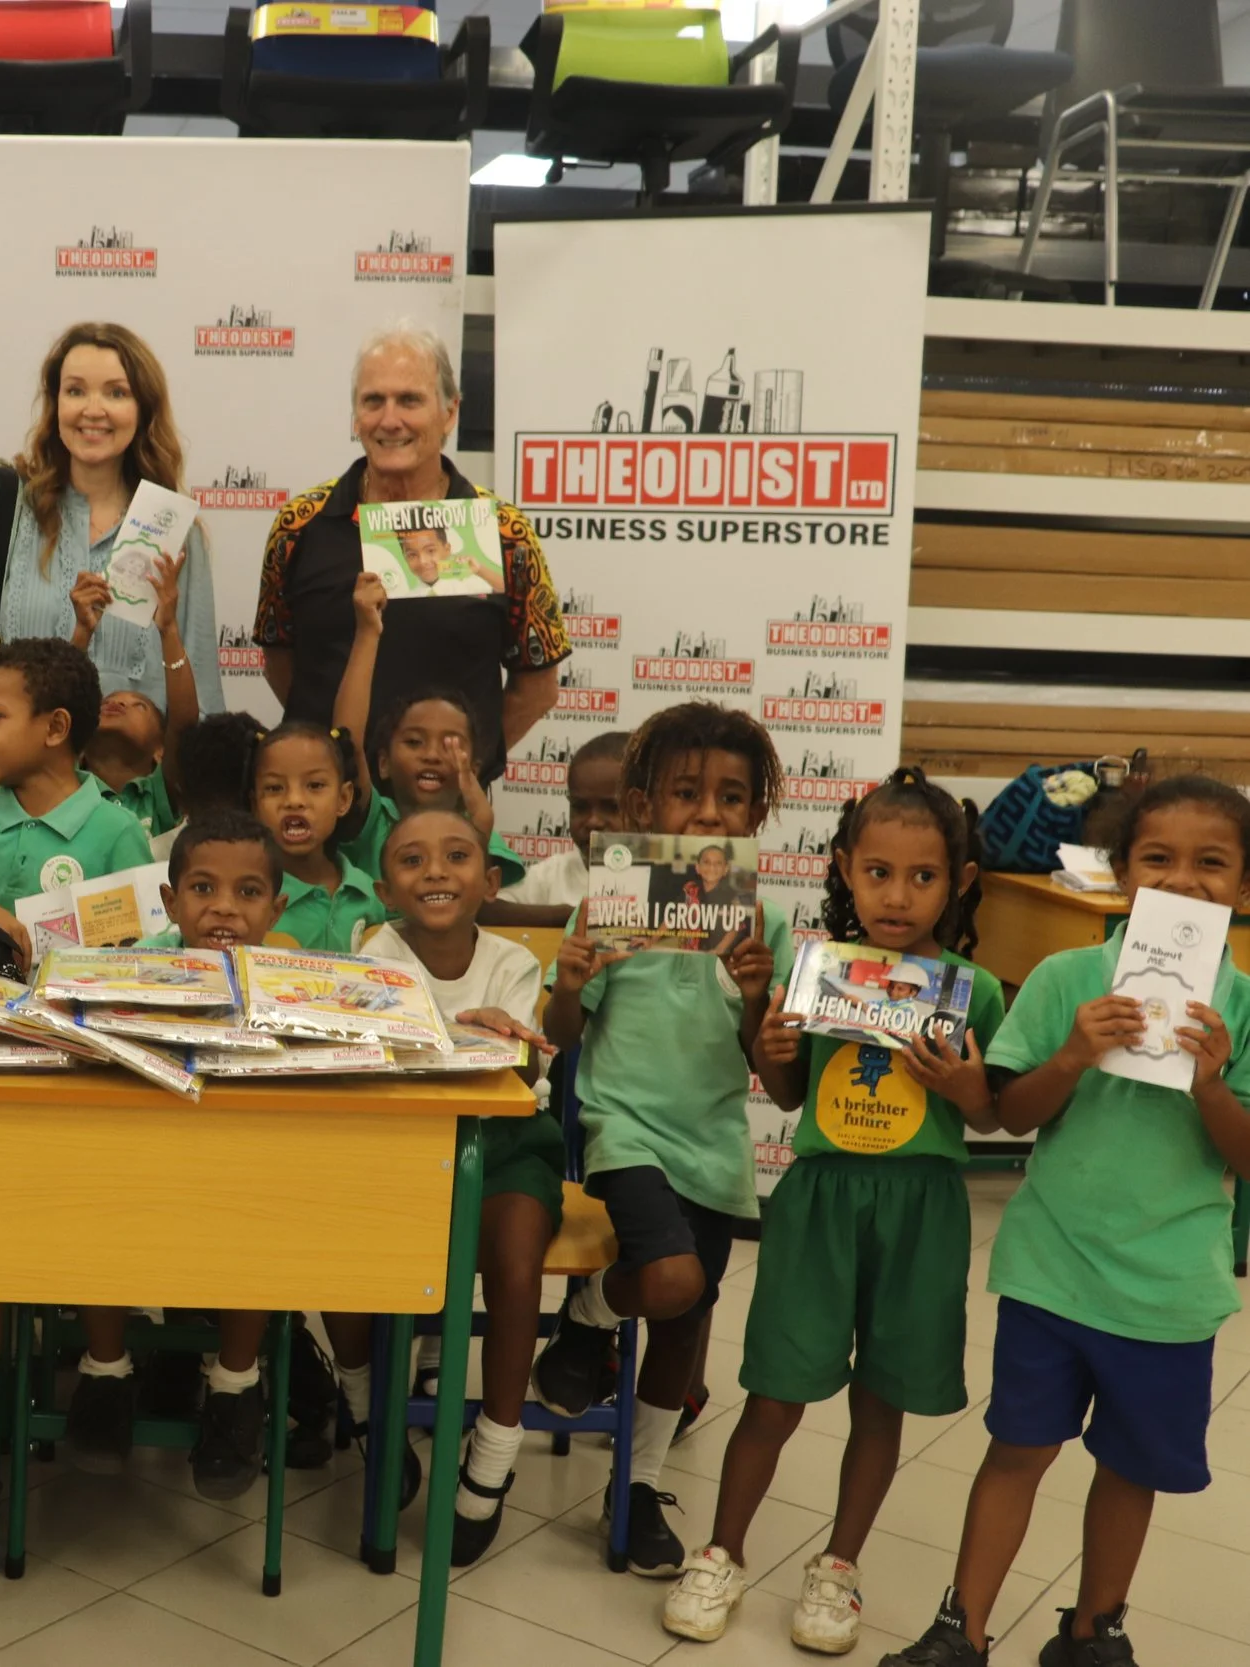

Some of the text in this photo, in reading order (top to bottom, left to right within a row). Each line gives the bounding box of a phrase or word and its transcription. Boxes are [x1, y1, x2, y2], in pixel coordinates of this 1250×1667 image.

[58, 250, 144, 266] THEODIST
[357, 254, 440, 272] THEODIST
[101, 270, 157, 278] SUPERSTORE
[197, 328, 281, 345] THEODIST
[238, 349, 294, 357] SUPERSTORE
[525, 447, 883, 500] THEODIST LTD
[367, 504, 491, 530] WHEN I GROW UP
[535, 517, 890, 546] USINESS SUPERSTORE
[770, 625, 874, 645] THEODIST
[220, 651, 258, 665] ODIS
[766, 648, 889, 659] BUSINESS SUPERSTORE
[636, 661, 736, 680] THEODIST
[632, 683, 751, 694] BUSINESS SUPERSTORE
[557, 691, 603, 711] DIST
[553, 713, 617, 723] SUPERSTORE
[764, 701, 868, 721] THEODIST
[766, 724, 883, 736] USINESS SUPERSTORE
[506, 763, 566, 783] THEOD
[503, 785, 548, 795] BUSINESS
[790, 780, 865, 799] EODIST
[759, 855, 824, 876] THEOD
[599, 900, 746, 932] WHEN I GROW UP
[1131, 939, 1183, 962] All about
[795, 992, 851, 1020] WHEN
[854, 1001, 862, 1022] I
[866, 1003, 926, 1036] GROW
[927, 1016, 954, 1040] UP
[830, 1097, 909, 1117] A brighter
[844, 1112, 892, 1130] future
[938, 1612, 961, 1628] port
